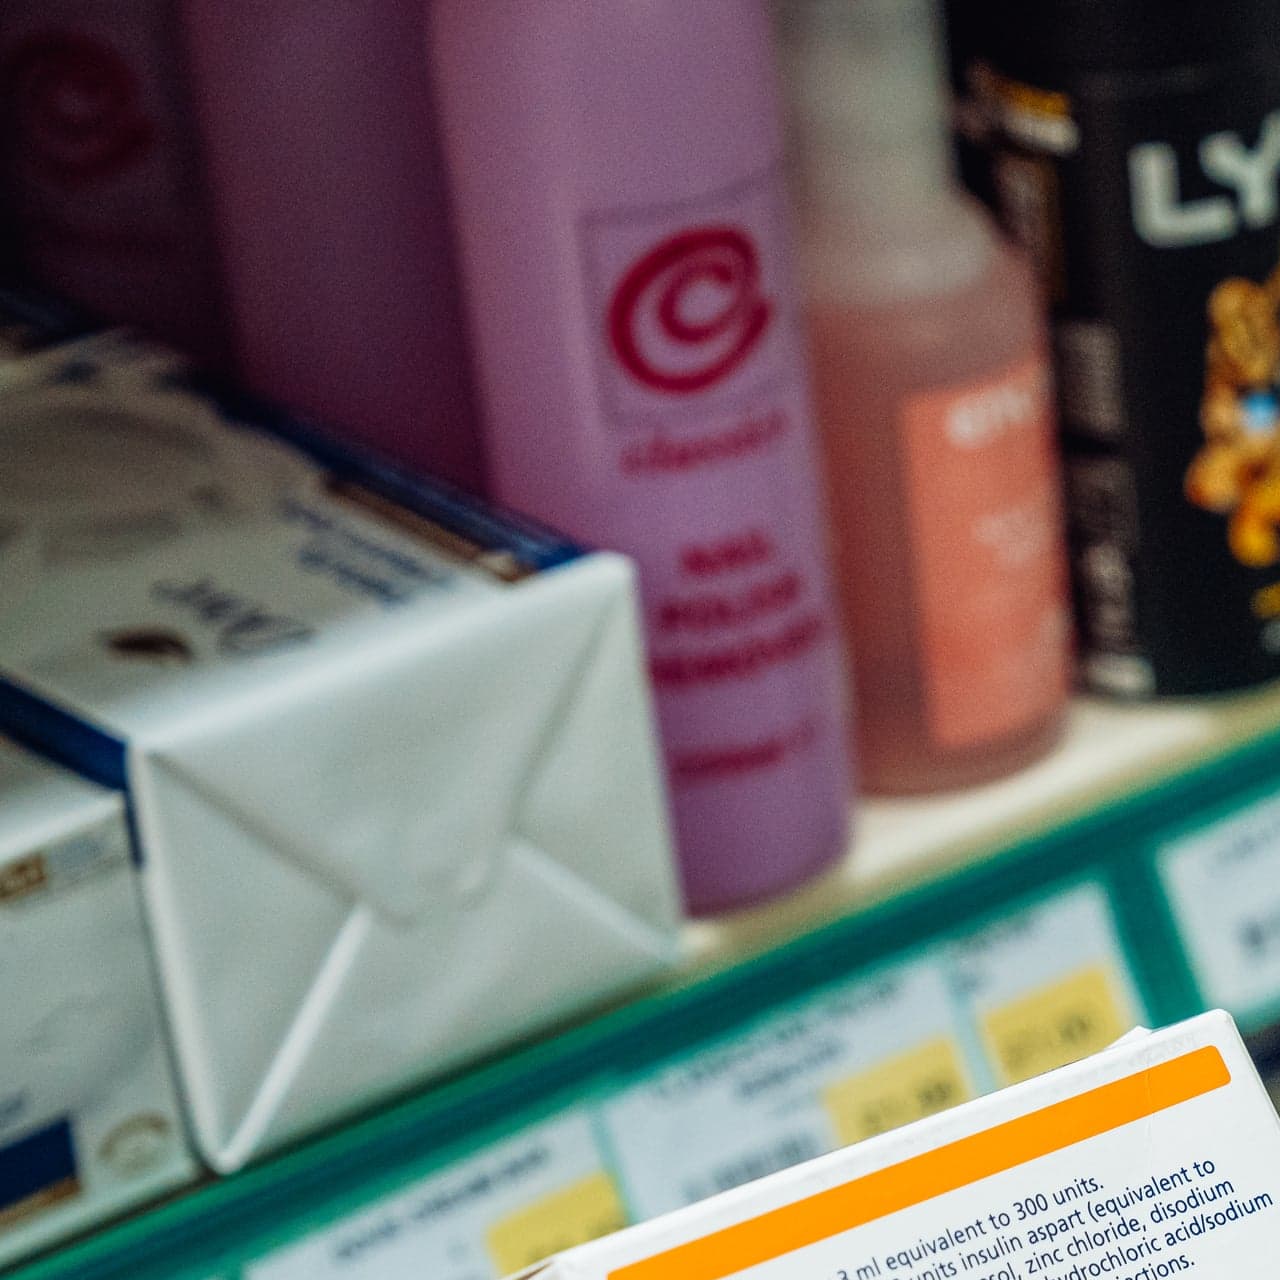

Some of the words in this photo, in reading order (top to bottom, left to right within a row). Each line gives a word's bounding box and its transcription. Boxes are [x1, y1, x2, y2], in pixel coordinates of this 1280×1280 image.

[884, 1217, 988, 1272] equivalent
[986, 1210, 1012, 1232] to
[1010, 1191, 1049, 1222] 300
[1049, 1175, 1105, 1207] units.
[956, 1233, 1024, 1272] insulin
[1025, 1207, 1086, 1246] aspart
[1085, 1165, 1193, 1224] (equivalent
[1191, 1158, 1216, 1178] to
[1023, 1244, 1065, 1275] zinc
[1065, 1214, 1148, 1257] chloride,
[1148, 1179, 1236, 1224] disodium
[1162, 1191, 1274, 1247] acid/sodium
